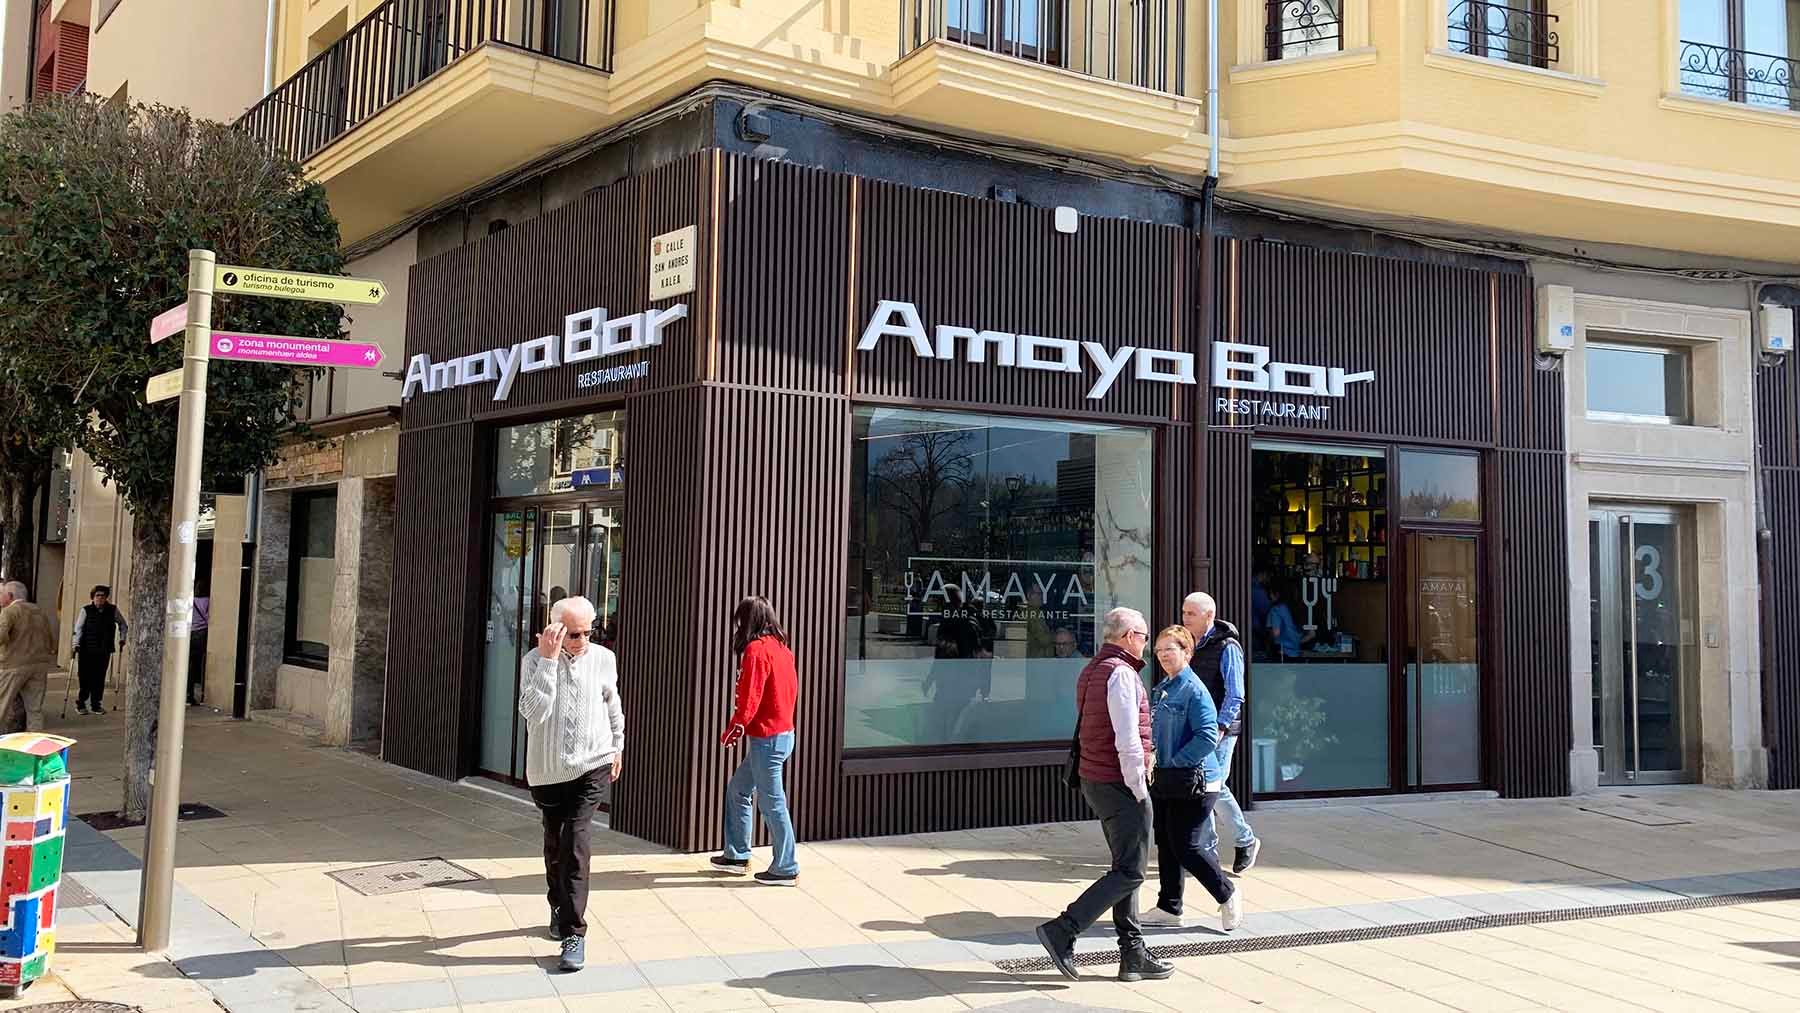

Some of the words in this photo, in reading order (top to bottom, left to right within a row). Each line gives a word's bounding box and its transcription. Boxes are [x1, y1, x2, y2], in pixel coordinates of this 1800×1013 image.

[666, 239, 684, 253] CALLE
[654, 262, 665, 273] SAN
[668, 255, 689, 269] ANDRES
[243, 273, 278, 284] oficina
[281, 277, 294, 285] de
[297, 278, 335, 289] turismo
[243, 282, 273, 290] turismo
[274, 285, 305, 294] bulegoa
[661, 275, 681, 288] KALEA
[239, 340, 264, 348] zona
[267, 342, 330, 352] monumental
[401, 334, 561, 402] Amaya
[564, 303, 688, 364] Bar
[857, 299, 1197, 399] Amaya
[1212, 341, 1375, 397] Bar
[296, 351, 318, 359] aldea
[578, 361, 650, 388] RESTAURANT
[1216, 397, 1331, 420] RESTAURANT
[1635, 545, 1663, 600] 3
[922, 570, 1088, 605] AMAYA
[1422, 583, 1461, 592] AMAYA
[943, 609, 968, 619] BAR
[983, 610, 1069, 620] RESTAURANTE
